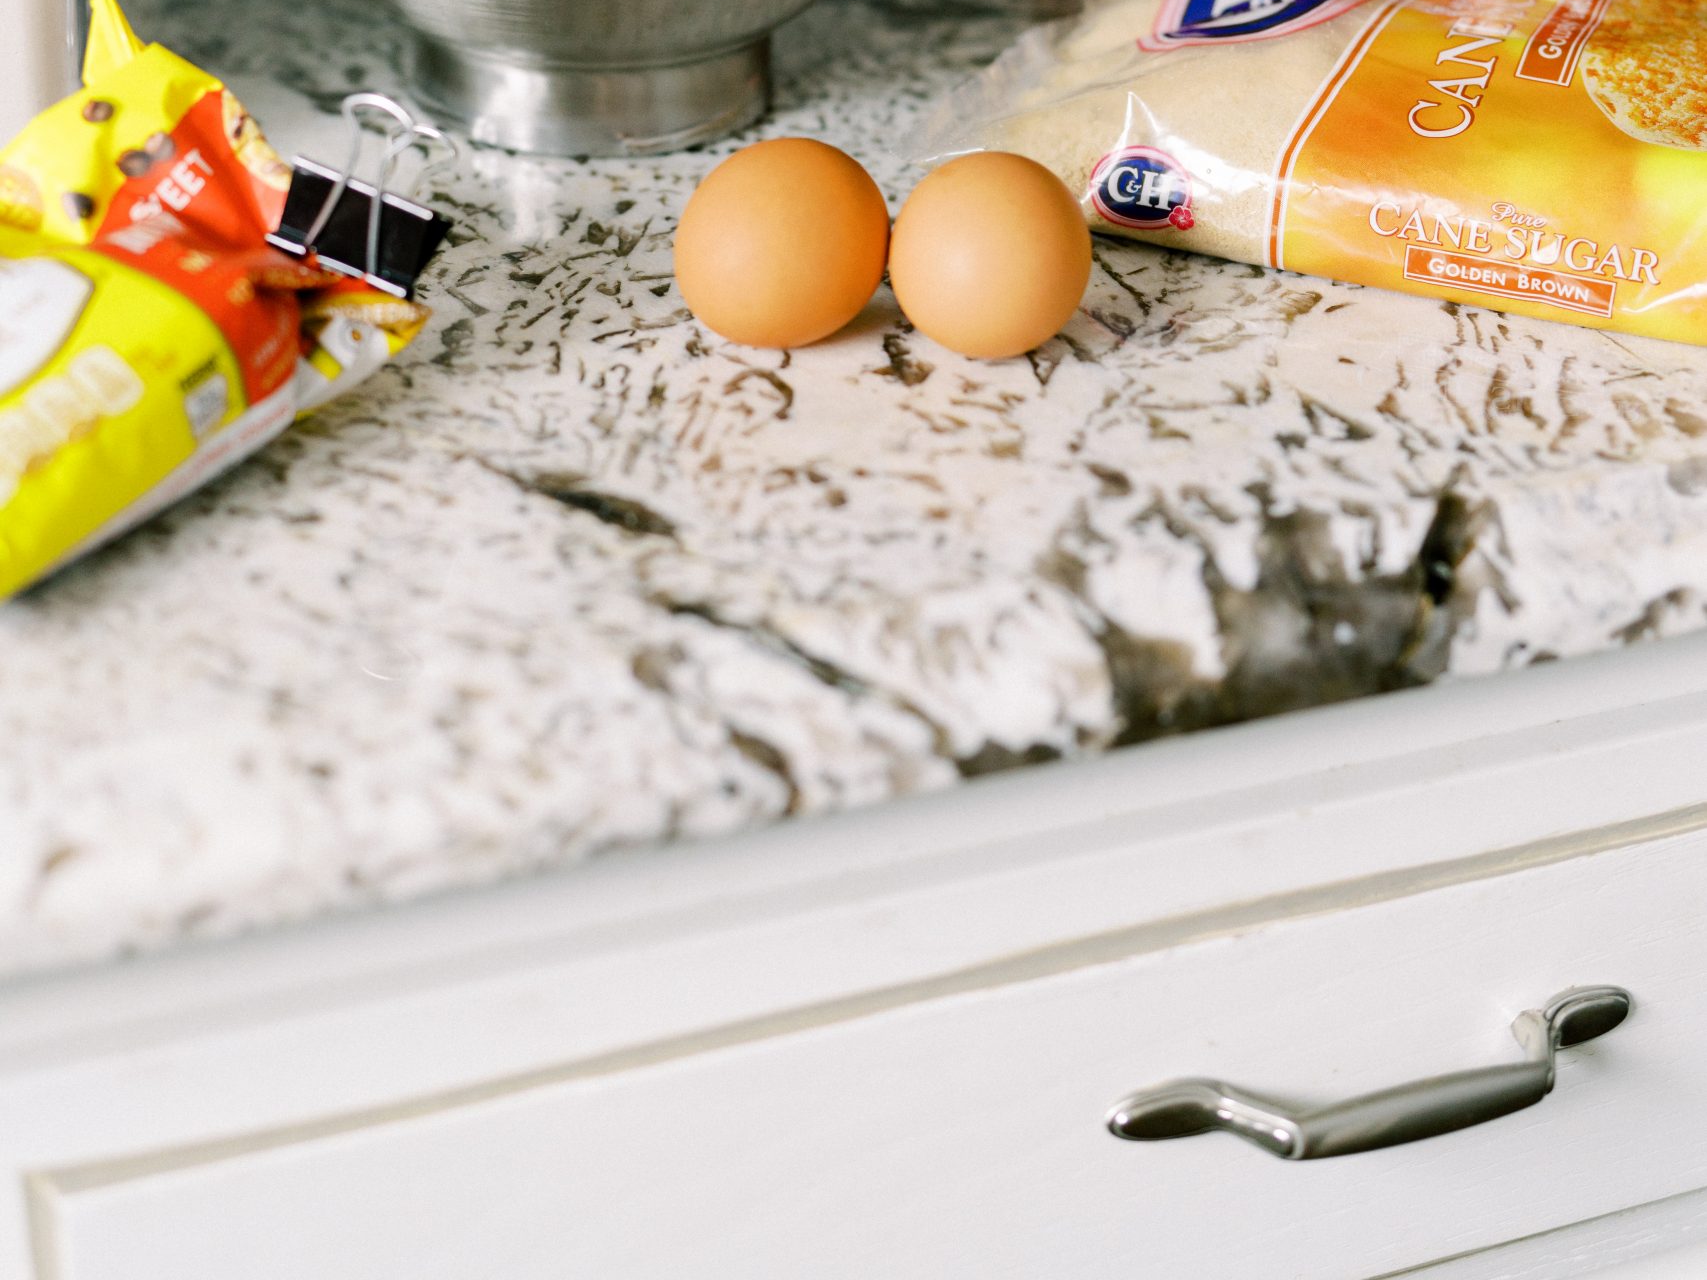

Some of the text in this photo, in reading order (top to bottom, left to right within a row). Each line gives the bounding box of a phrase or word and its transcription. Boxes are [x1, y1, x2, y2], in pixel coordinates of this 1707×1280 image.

[1107, 166, 1175, 210] C&H
[1491, 202, 1547, 229] Pure
[1369, 200, 1660, 285] CANE SUGAR
[1428, 257, 1590, 302] GOLDEN BROWN
